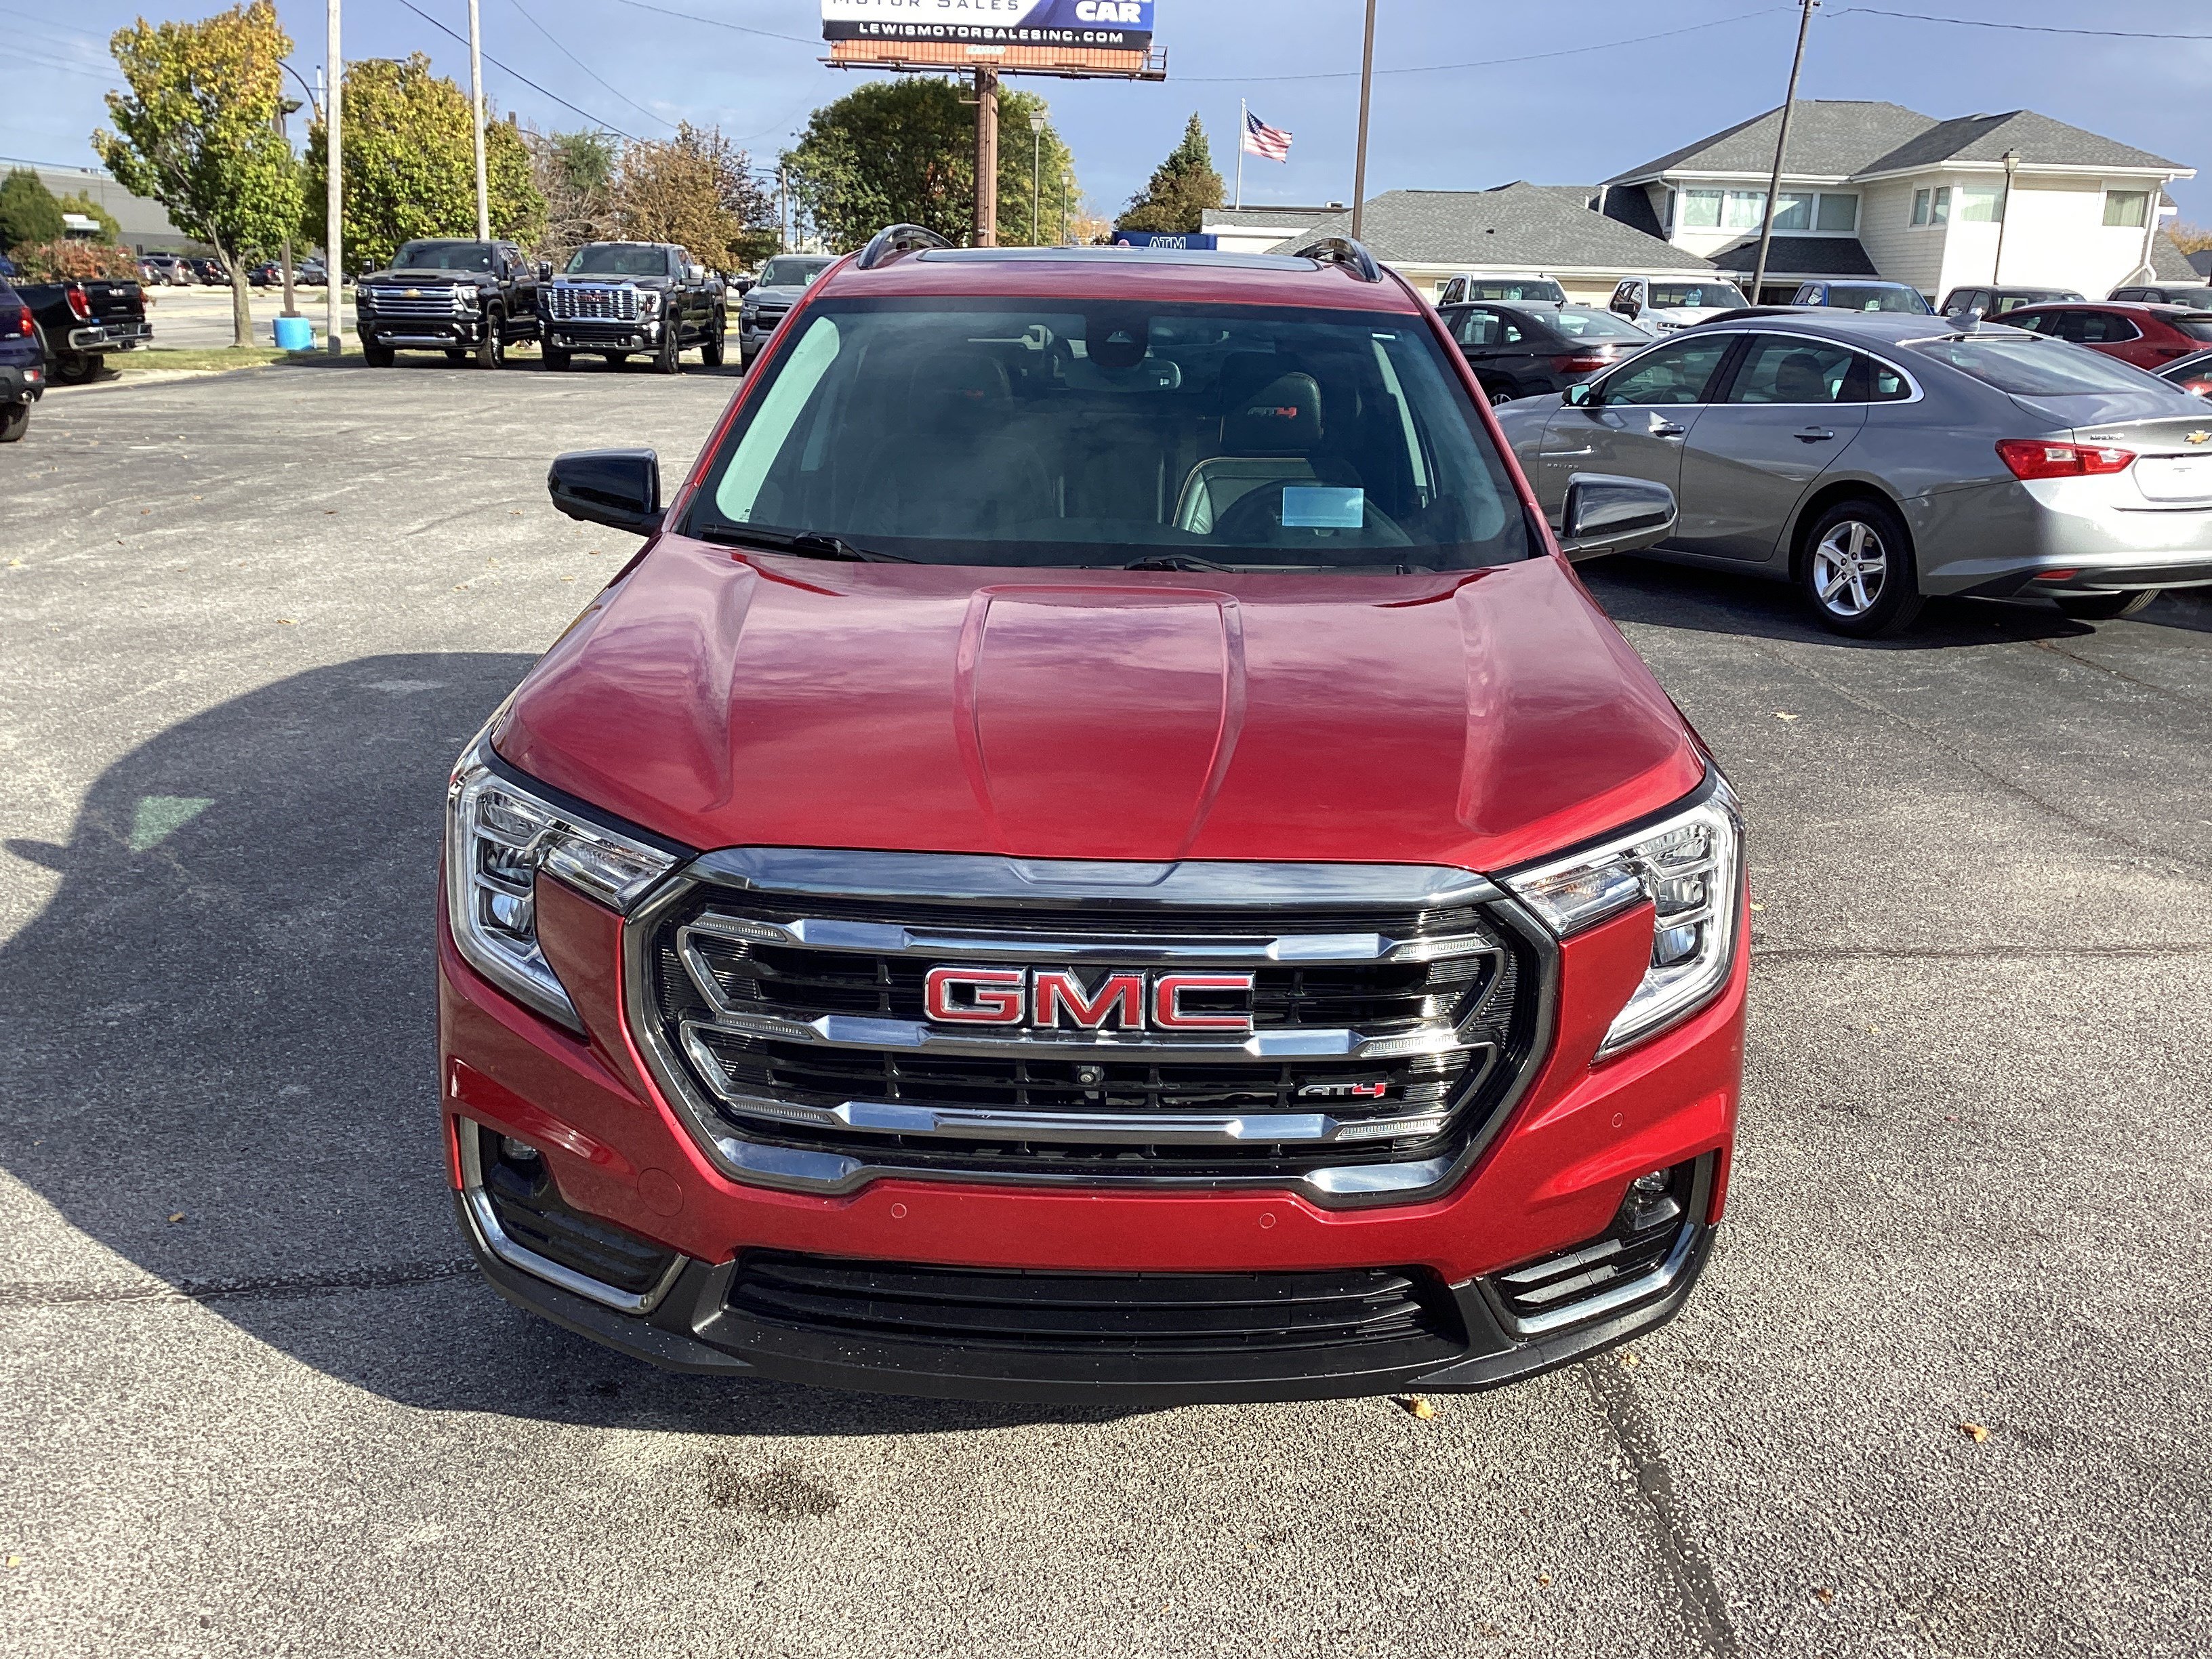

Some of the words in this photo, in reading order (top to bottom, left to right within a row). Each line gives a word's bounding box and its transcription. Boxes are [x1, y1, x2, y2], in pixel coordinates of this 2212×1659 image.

[1076, 1, 1141, 22] CAR
[859, 22, 1124, 43] LEWISMOTORSALESINC.COM
[1149, 237, 1186, 249] ATM
[924, 965, 1256, 1031] GMC
[1298, 1082, 1386, 1099] AT4
